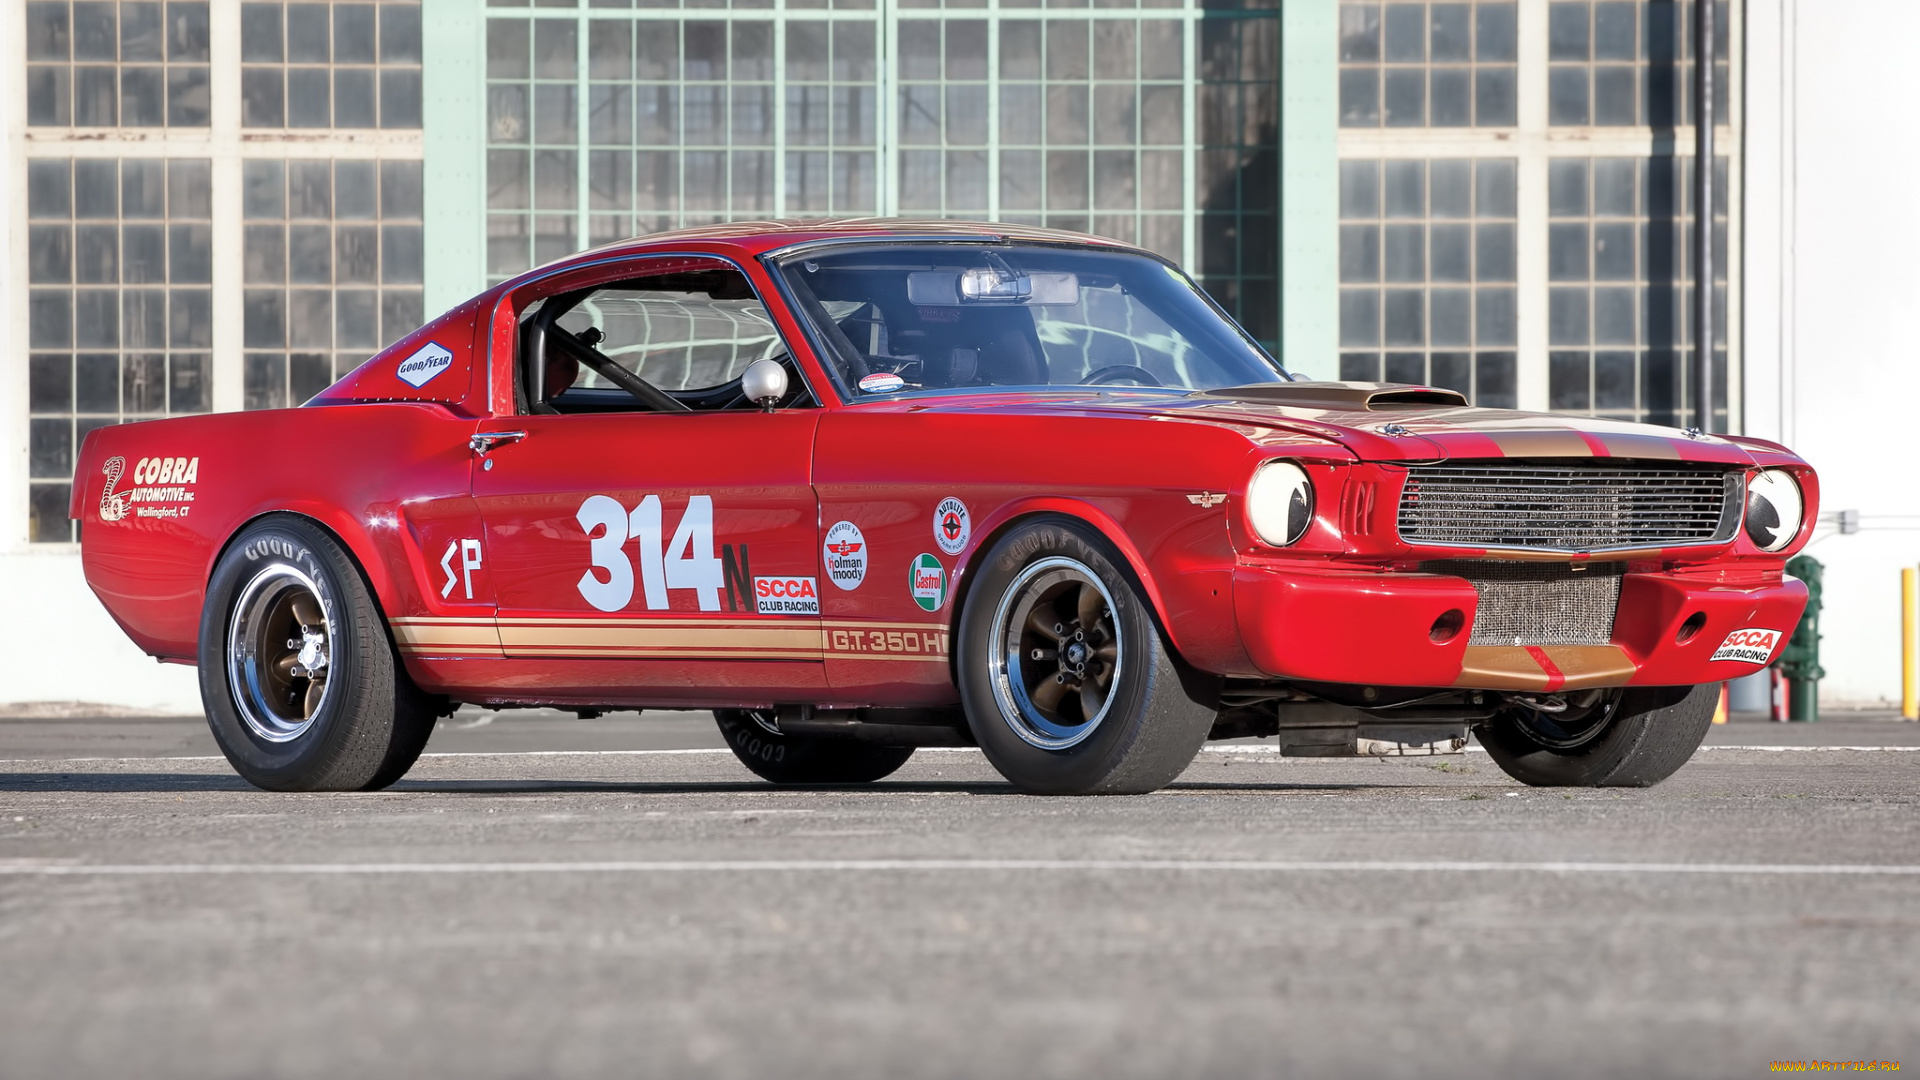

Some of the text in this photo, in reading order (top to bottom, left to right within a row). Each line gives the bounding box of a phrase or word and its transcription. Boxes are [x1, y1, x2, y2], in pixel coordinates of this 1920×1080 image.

[400, 356, 450, 373] GOODYEAR
[134, 457, 199, 485] COBRA
[130, 487, 185, 502] AUTOMOTIVE
[137, 506, 190, 519] Wallingford, CT
[939, 501, 966, 520] AUTOLITE
[829, 523, 859, 539] POWERED BY
[576, 495, 755, 612] 314 N
[828, 556, 862, 570] holman
[833, 567, 863, 580] moody
[915, 569, 942, 589] Castrol
[756, 579, 816, 598] SCCA
[759, 601, 818, 612] CLUB RACING
[869, 631, 920, 652] 350
[1722, 631, 1774, 650] SCCA
[1714, 649, 1768, 661] CLUB RACING
